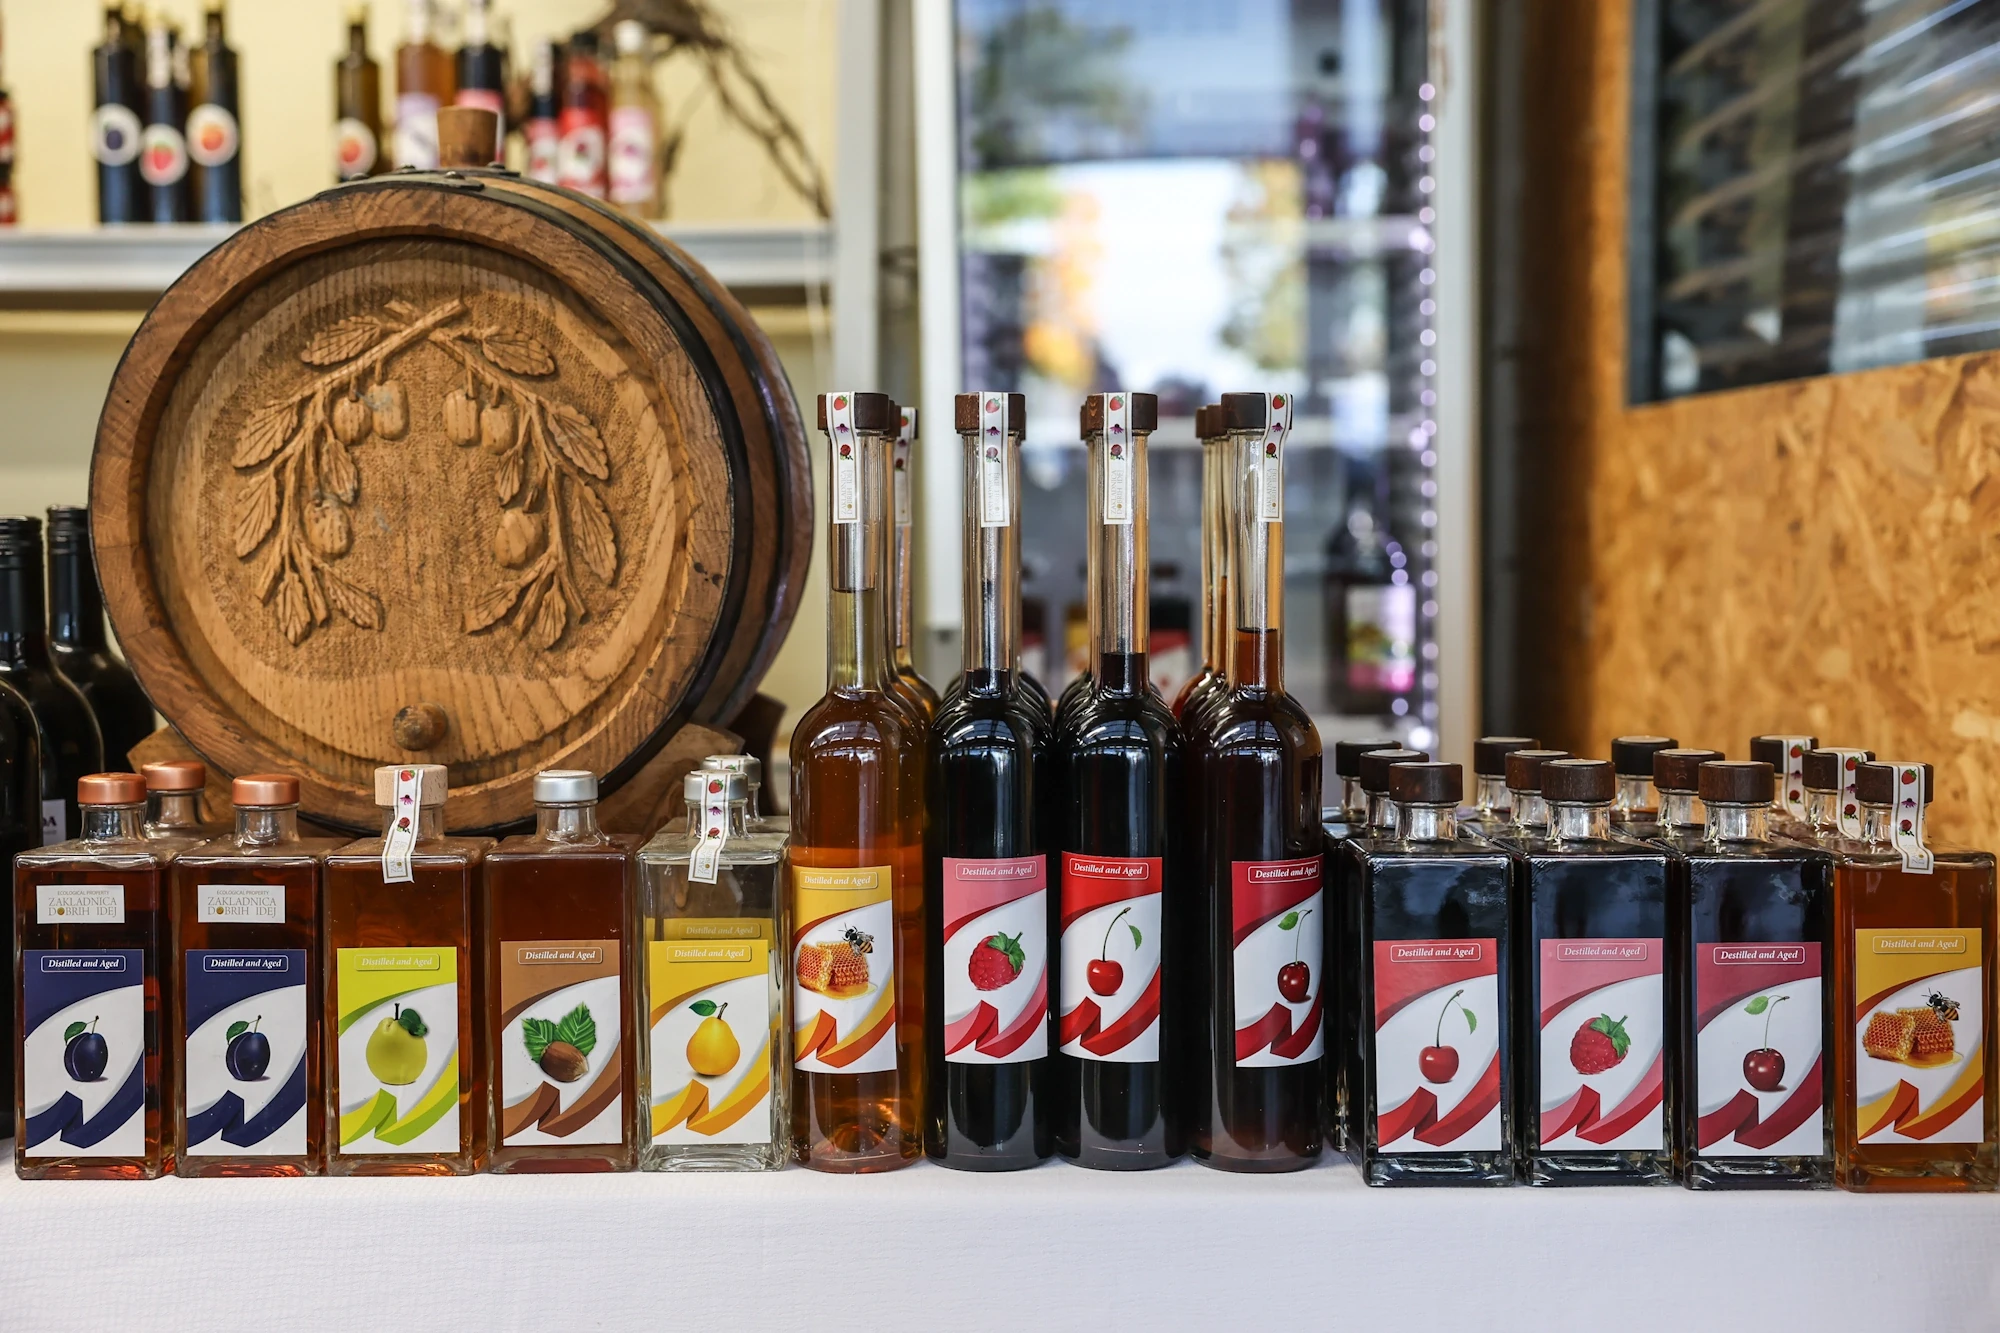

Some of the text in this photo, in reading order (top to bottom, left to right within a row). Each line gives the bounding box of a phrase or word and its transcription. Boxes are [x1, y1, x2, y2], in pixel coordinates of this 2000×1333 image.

[962, 865, 1032, 876] Destilled and Aged
[1074, 862, 1143, 877] Destilled and Aged
[1255, 864, 1317, 878] Destilled and Aged
[804, 876, 832, 884] Distilled
[851, 876, 871, 886] Aged
[48, 897, 117, 906] ZAKLADNICA
[208, 896, 276, 906] ZAKLADNICA
[96, 907, 117, 918] IDEJ
[256, 907, 276, 918] IDEJ
[718, 926, 733, 934] and
[1880, 939, 1958, 950] Distilled and Aged
[525, 950, 596, 961] Distilled and Aged
[674, 949, 745, 959] Distilled and Aged
[1398, 947, 1474, 958] Destilled and Aged
[1564, 947, 1641, 957] Destilled and Aged
[1720, 950, 1798, 961] Destilled and Aged
[48, 959, 120, 969] Distilled and Aged
[211, 959, 282, 969] Distilled and Aged
[362, 957, 432, 967] Distilled and Aged
